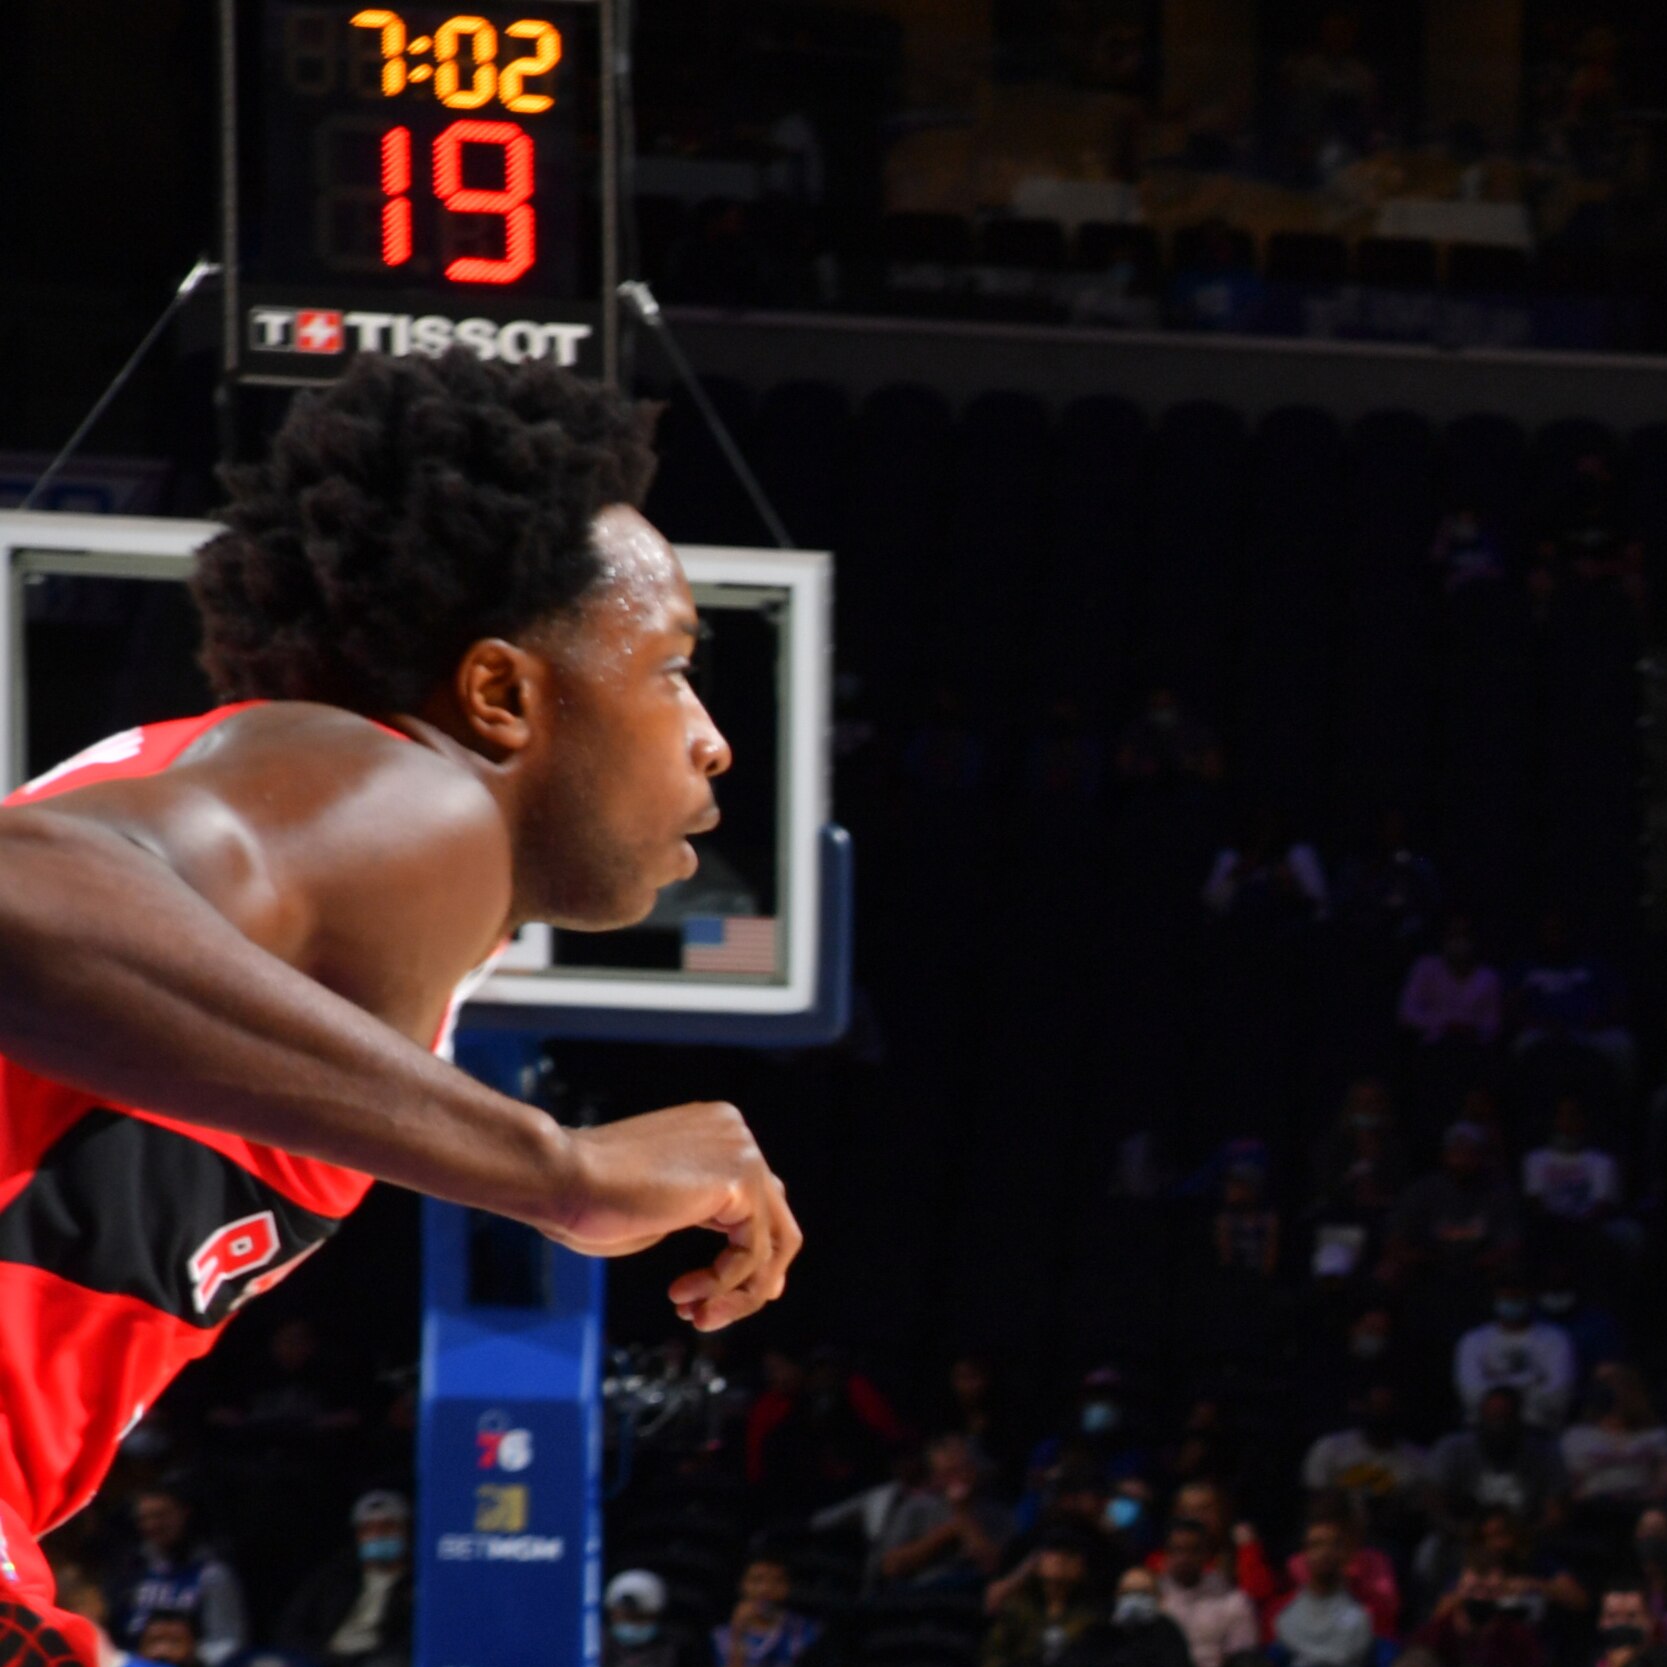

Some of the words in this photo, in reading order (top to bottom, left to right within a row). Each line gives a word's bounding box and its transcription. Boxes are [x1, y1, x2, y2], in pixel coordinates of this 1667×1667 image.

[350, 9, 562, 113] 7:02
[381, 119, 535, 284] 19
[345, 311, 592, 366] TISSOT
[475, 1428, 533, 1472] 76
